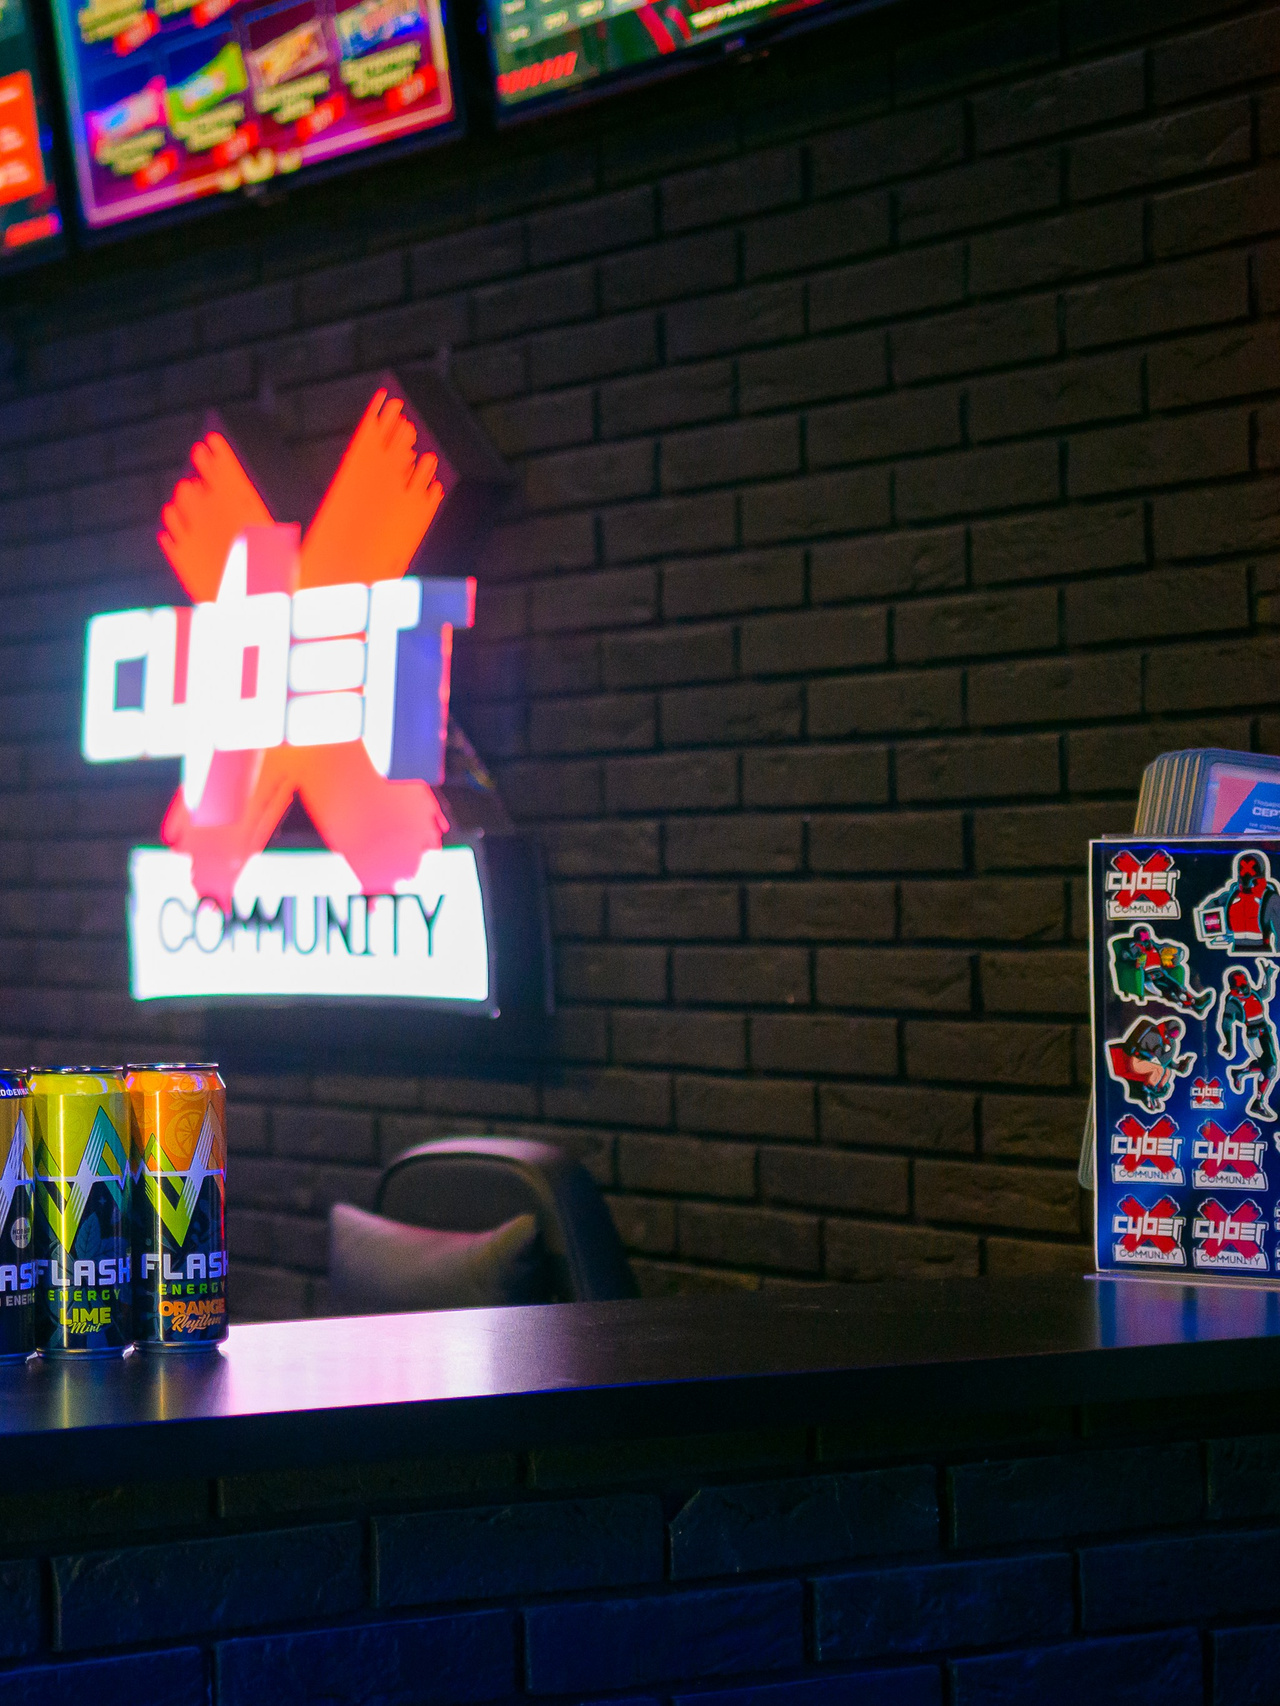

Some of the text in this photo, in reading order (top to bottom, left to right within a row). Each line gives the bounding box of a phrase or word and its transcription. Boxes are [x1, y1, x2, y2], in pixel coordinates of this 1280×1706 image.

[1114, 903, 1173, 915] COMMUNITY
[157, 893, 448, 958] COMMUNITY
[1119, 1168, 1177, 1180] COMMUNITY
[1199, 1174, 1260, 1185] COMMUNITY
[1120, 1249, 1178, 1260] COMMUNITY
[1200, 1253, 1260, 1265] COMMUNITY
[36, 1256, 131, 1287] FLASH
[141, 1251, 228, 1280] FLASH
[48, 1288, 121, 1302] ENERGY
[158, 1281, 225, 1296] ENERGY
[158, 1297, 225, 1317] ORANGE
[59, 1306, 112, 1325] LIME
[67, 1321, 102, 1334] Mint
[171, 1314, 222, 1333] Rhythm
